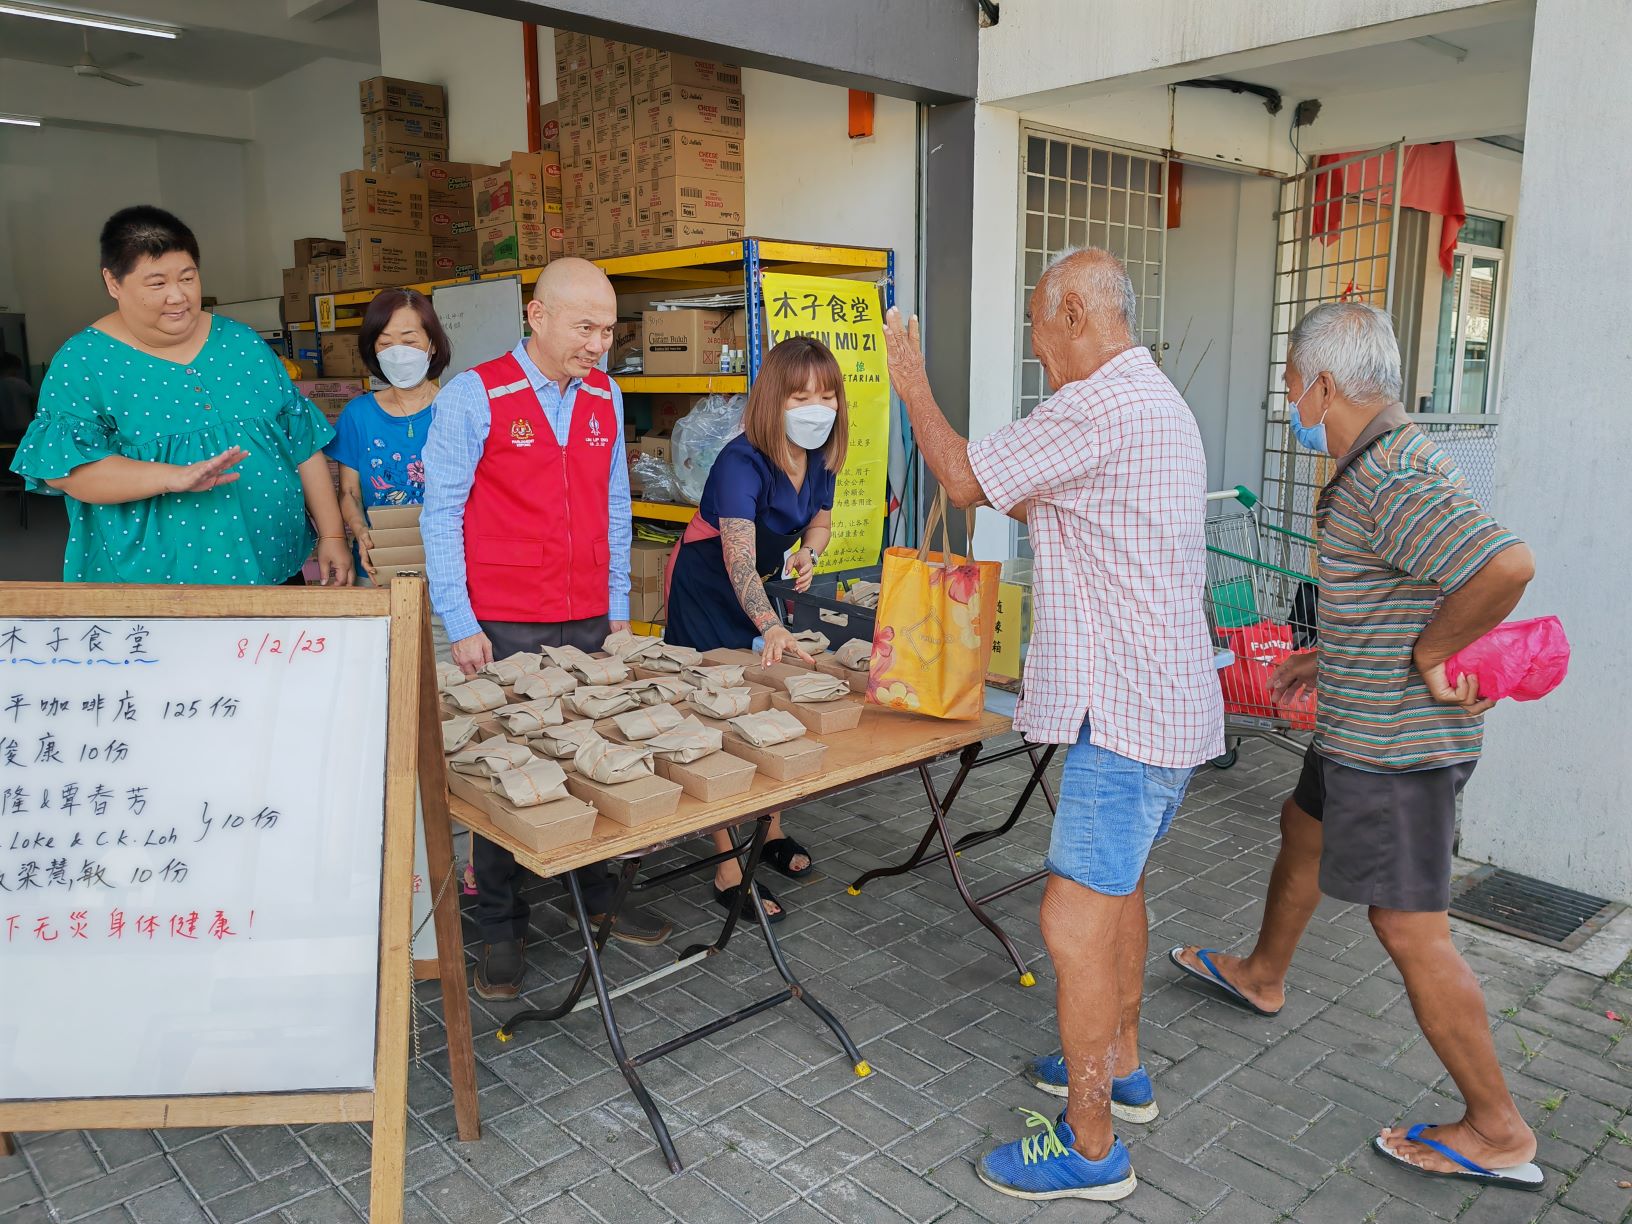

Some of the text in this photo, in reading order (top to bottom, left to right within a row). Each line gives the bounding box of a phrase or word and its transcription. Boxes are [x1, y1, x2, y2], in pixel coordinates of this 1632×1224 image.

[773, 291, 873, 324] 木子食堂
[835, 332, 858, 351] MU
[862, 333, 877, 352] ZI
[0, 624, 150, 654] 木子食堂
[4, 690, 138, 728] 平咖啡店
[144, 827, 178, 849] Loh
